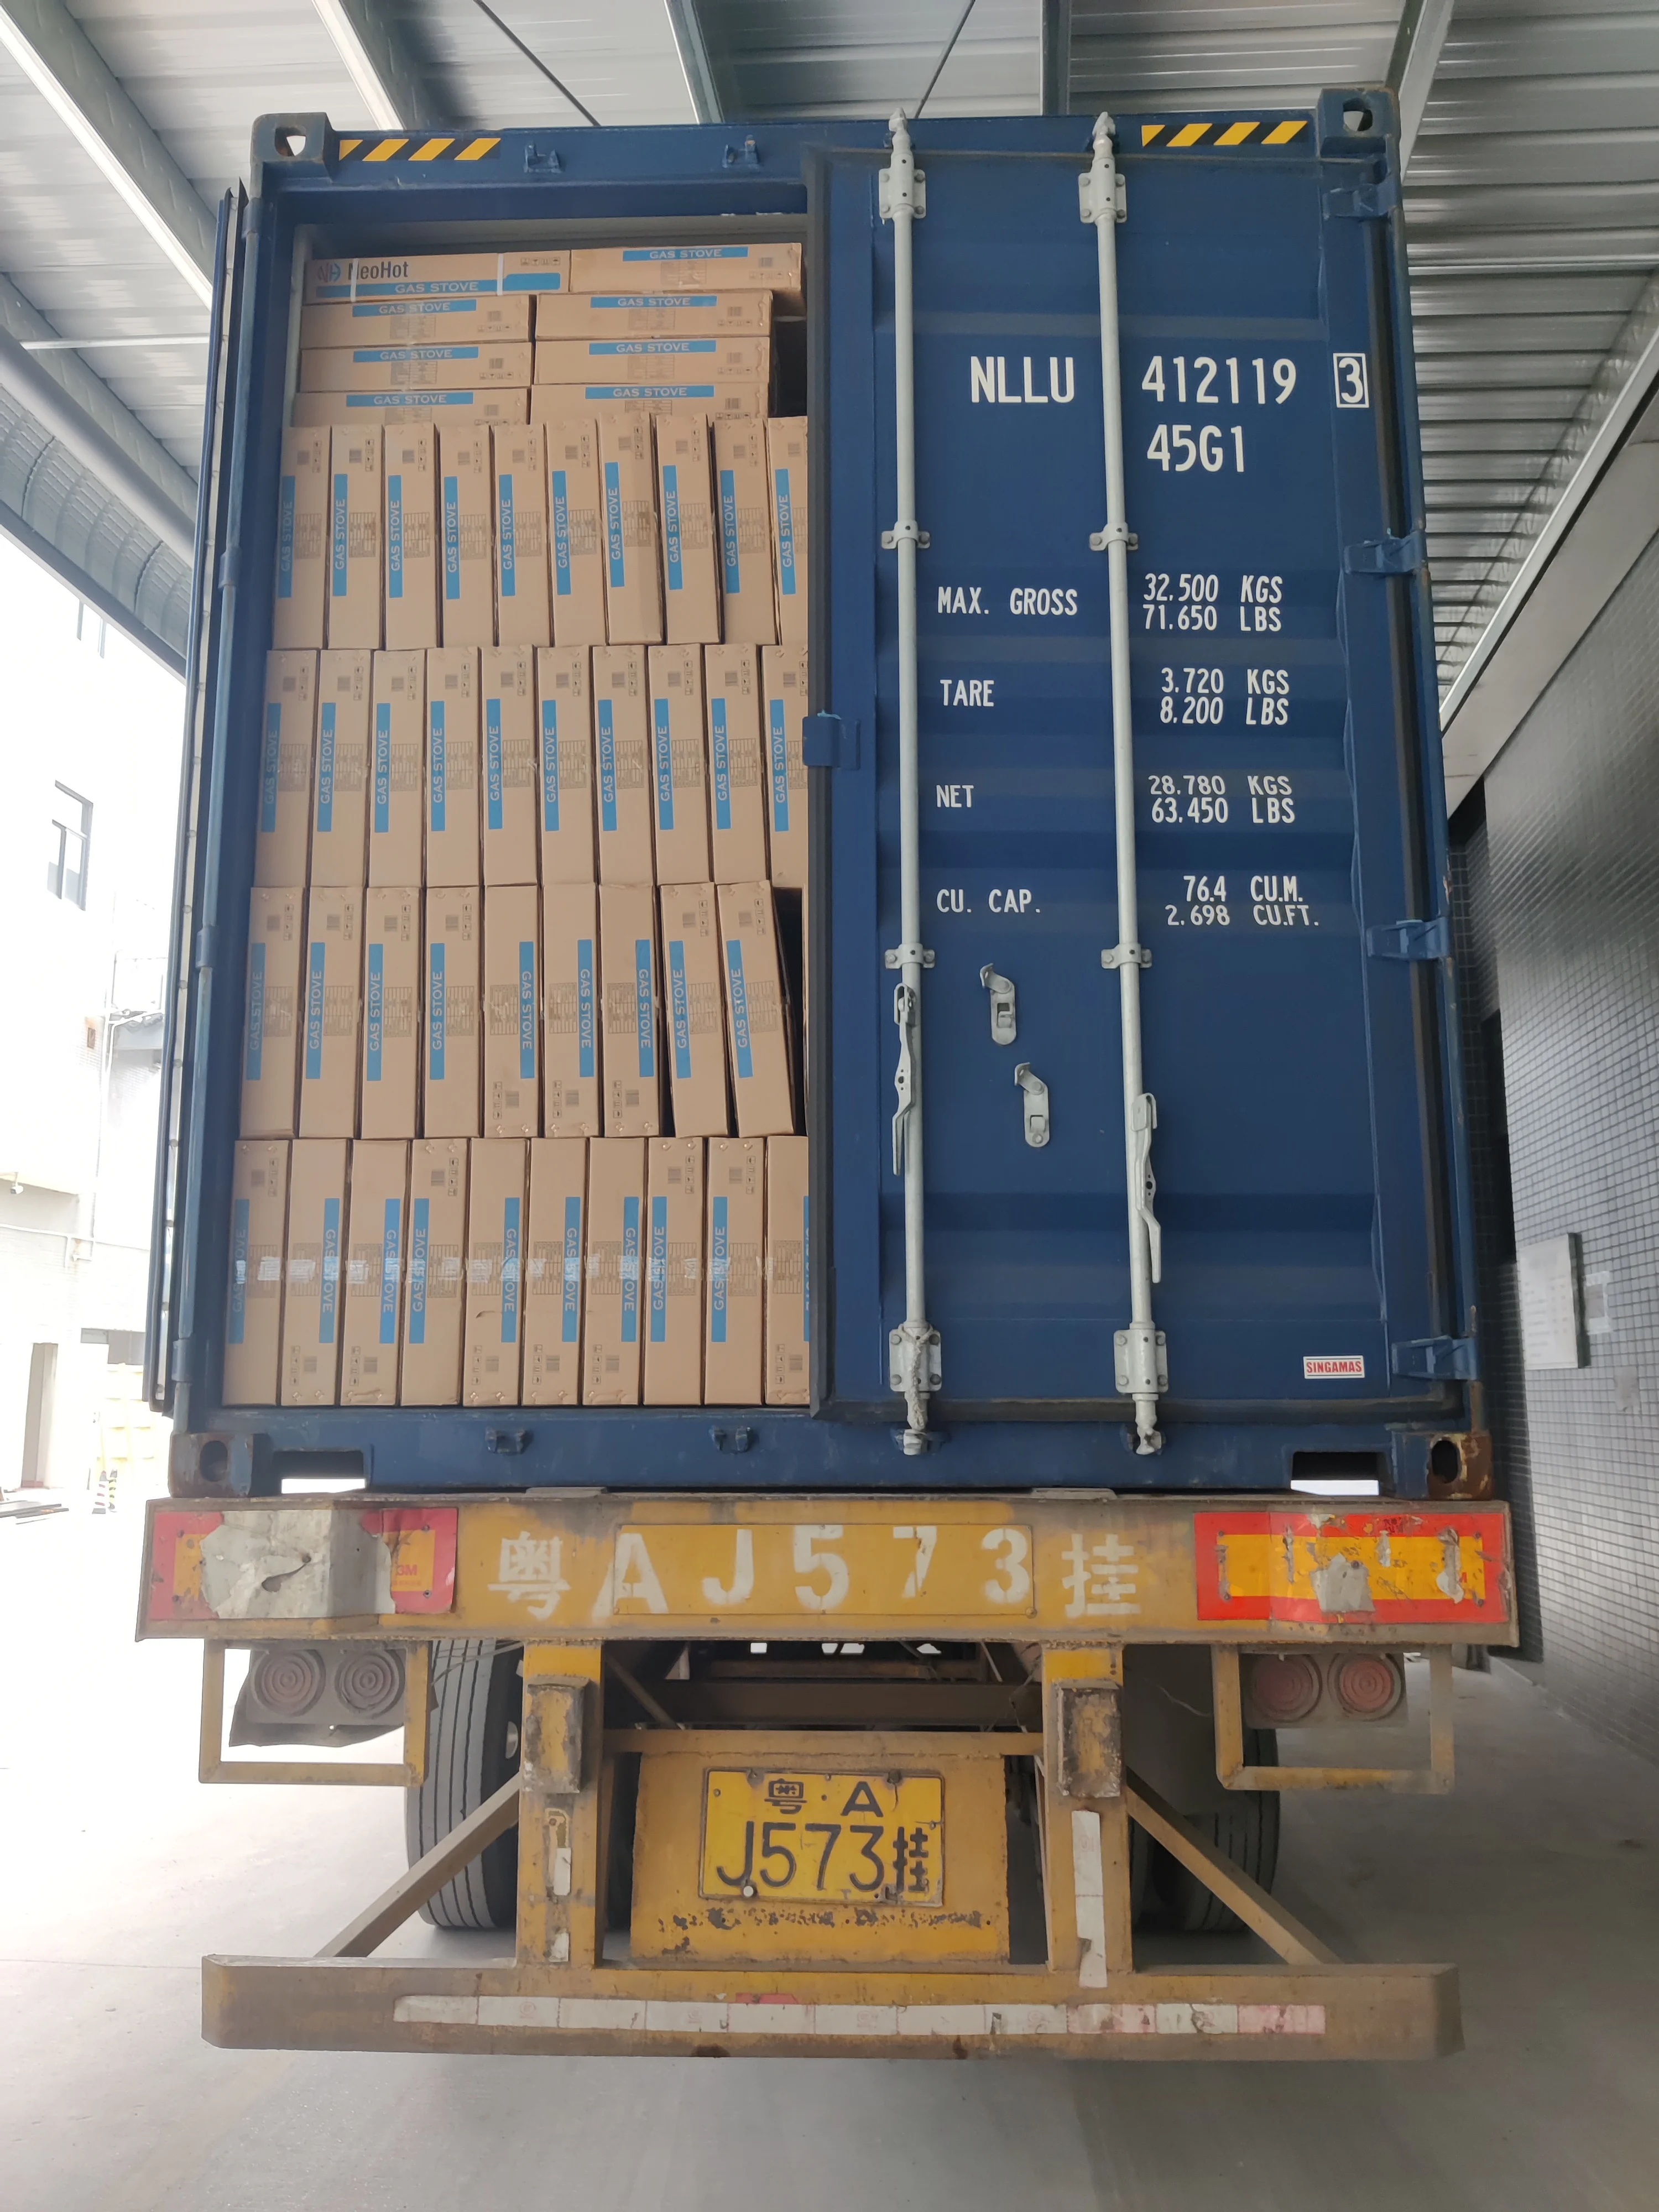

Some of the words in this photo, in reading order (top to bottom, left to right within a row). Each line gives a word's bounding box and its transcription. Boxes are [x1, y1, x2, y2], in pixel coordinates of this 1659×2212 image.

[650, 251, 675, 259] GAS
[680, 249, 722, 258] STOVE
[395, 283, 424, 294] GAS
[430, 282, 478, 292] STOVE
[618, 298, 644, 306] GAS
[648, 298, 690, 306] STOVE
[379, 304, 406, 314] GAS
[409, 302, 450, 312] STOVE
[380, 351, 406, 361] GAS
[409, 349, 452, 359] STOVE
[616, 344, 642, 352] GAS
[647, 343, 690, 352] STOVE
[613, 388, 639, 397] GAS
[644, 387, 687, 396] STOVE
[971, 356, 1074, 403] NLLU
[1141, 356, 1296, 404] 412119
[1338, 358, 1363, 403] 3
[374, 396, 400, 405] GAS
[405, 394, 446, 404] STOVE
[1147, 424, 1244, 472] 45G1
[282, 502, 292, 542] STOVE
[336, 499, 346, 540] STOVE
[390, 500, 400, 541] STOVE
[446, 502, 456, 543] STOVE
[502, 499, 512, 540] STOVE
[555, 497, 566, 538] STOVE
[608, 488, 619, 530] STOVE
[666, 491, 677, 534] STOVE
[723, 495, 733, 537] STOVE
[779, 494, 790, 538] STOVE
[281, 546, 290, 571] GAS
[335, 545, 344, 570] GAS
[392, 546, 400, 571] GAS
[448, 547, 457, 572] GAS
[503, 545, 512, 570] GAS
[557, 541, 567, 568] GAS
[611, 534, 620, 560] GAS
[669, 538, 679, 563] GAS
[726, 541, 736, 566] GAS
[782, 541, 792, 567] GAS
[938, 587, 989, 614] MAX.
[1010, 588, 1077, 615] GROSS
[1241, 575, 1283, 603] KGS
[1142, 604, 1218, 631] 71.650
[1240, 607, 1281, 632] LBS
[940, 680, 994, 707] TARE
[1161, 667, 1224, 694] 3.720
[1247, 669, 1289, 695] KGS
[1160, 696, 1224, 724] 8.200
[1246, 698, 1288, 726] LBS
[267, 730, 278, 775] STOVE
[322, 729, 333, 773] STOVE
[378, 730, 388, 773] STOVE
[432, 728, 443, 773] STOVE
[489, 726, 499, 771] STOVE
[545, 727, 556, 772] STOVE
[601, 727, 612, 772] STOVE
[657, 726, 669, 770] STOVE
[714, 726, 726, 770] STOVE
[773, 726, 784, 773] STOVE
[264, 778, 275, 804] GAS
[320, 777, 331, 804] GAS
[377, 778, 387, 805] GAS
[433, 776, 443, 803] GAS
[490, 775, 500, 801] GAS
[546, 776, 556, 803] GAS
[603, 776, 614, 803] GAS
[660, 774, 670, 801] GAS
[718, 774, 728, 801] GAS
[775, 776, 786, 804] GAS
[936, 785, 974, 808] NET
[1148, 775, 1225, 795] 28.780
[1248, 775, 1292, 796] KGS
[1151, 797, 1229, 824] 63.450
[1251, 798, 1295, 823] LBS
[936, 889, 971, 914] CU.
[988, 889, 1041, 914] CAP.
[1183, 875, 1227, 902] 76.4
[1250, 875, 1303, 902] CU.M.
[251, 972, 263, 1021] STOVE
[310, 971, 322, 1020] STOVE
[369, 972, 380, 1021] STOVE
[432, 972, 442, 1020] STOVE
[521, 971, 531, 999] GAS
[581, 969, 590, 997] GAS
[639, 969, 649, 997] GAS
[672, 969, 685, 1018] STOVE
[731, 969, 744, 1019] STOVE
[249, 1022, 260, 1050] GAS
[309, 1021, 320, 1049] GAS
[369, 1022, 380, 1051] GAS
[432, 1022, 442, 1050] GAS
[521, 1000, 532, 1050] STOVE
[581, 999, 591, 1048] STOVE
[639, 999, 651, 1048] STOVE
[676, 1020, 687, 1048] GAS
[736, 1020, 747, 1048] GAS
[325, 1229, 336, 1257] GAS
[385, 1229, 397, 1259] GAS
[505, 1228, 517, 1258] GAS
[566, 1227, 577, 1258] GAS
[625, 1228, 636, 1258] GAS
[413, 1281, 424, 1312] GAS
[653, 1279, 664, 1310] GAS
[714, 1279, 724, 1310] GAS
[1306, 1361, 1362, 1373] SINGAMAS
[397, 1564, 418, 1575] 3M
[840, 1781, 884, 1817] A
